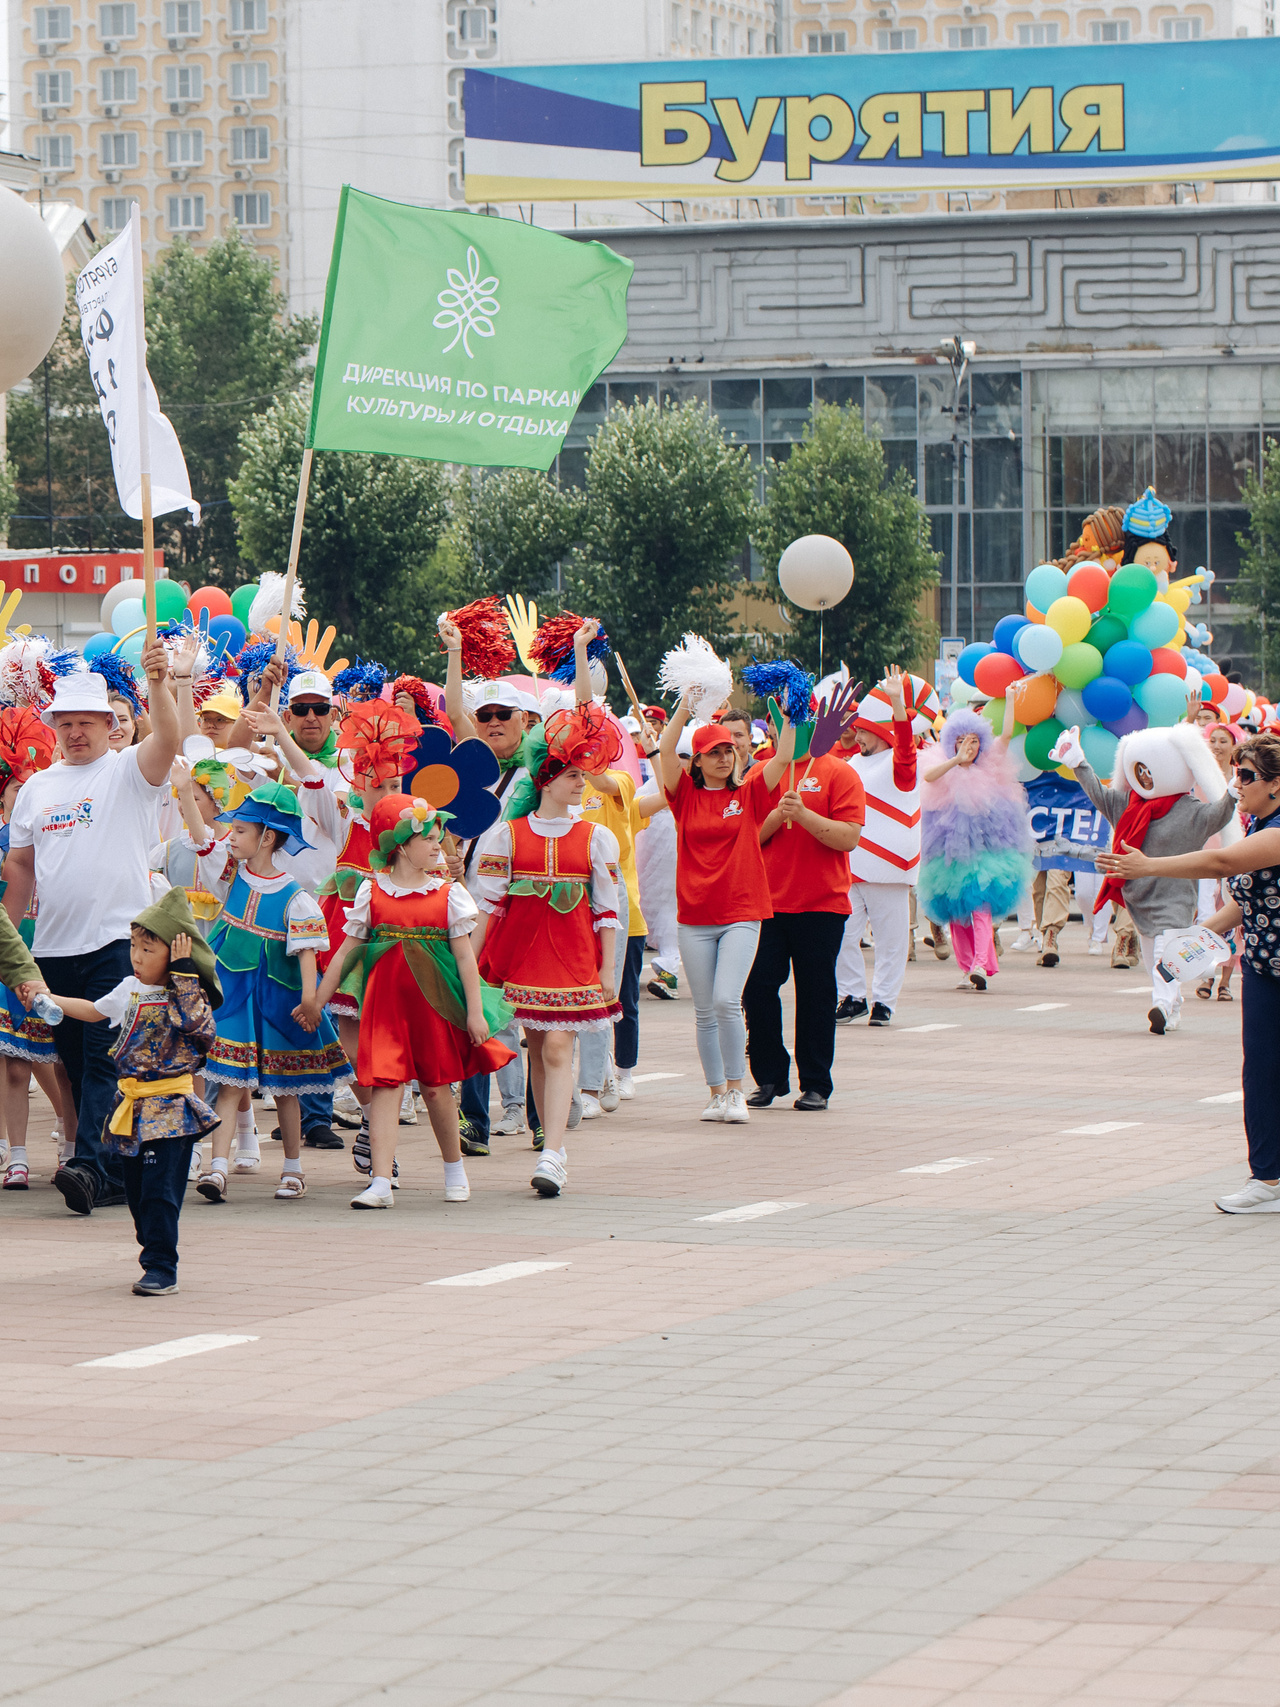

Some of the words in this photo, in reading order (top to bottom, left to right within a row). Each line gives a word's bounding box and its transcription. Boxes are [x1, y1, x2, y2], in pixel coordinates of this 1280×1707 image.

[640, 80, 1125, 182] Бурятия
[342, 362, 452, 395] ДИРЕКЦИЯ
[456, 379, 488, 399] ПО
[493, 386, 581, 407] ПАРКАМ
[346, 395, 456, 424] КУЛЬТУРЫ
[457, 410, 476, 425] И
[477, 412, 569, 437] ОТДЫХА
